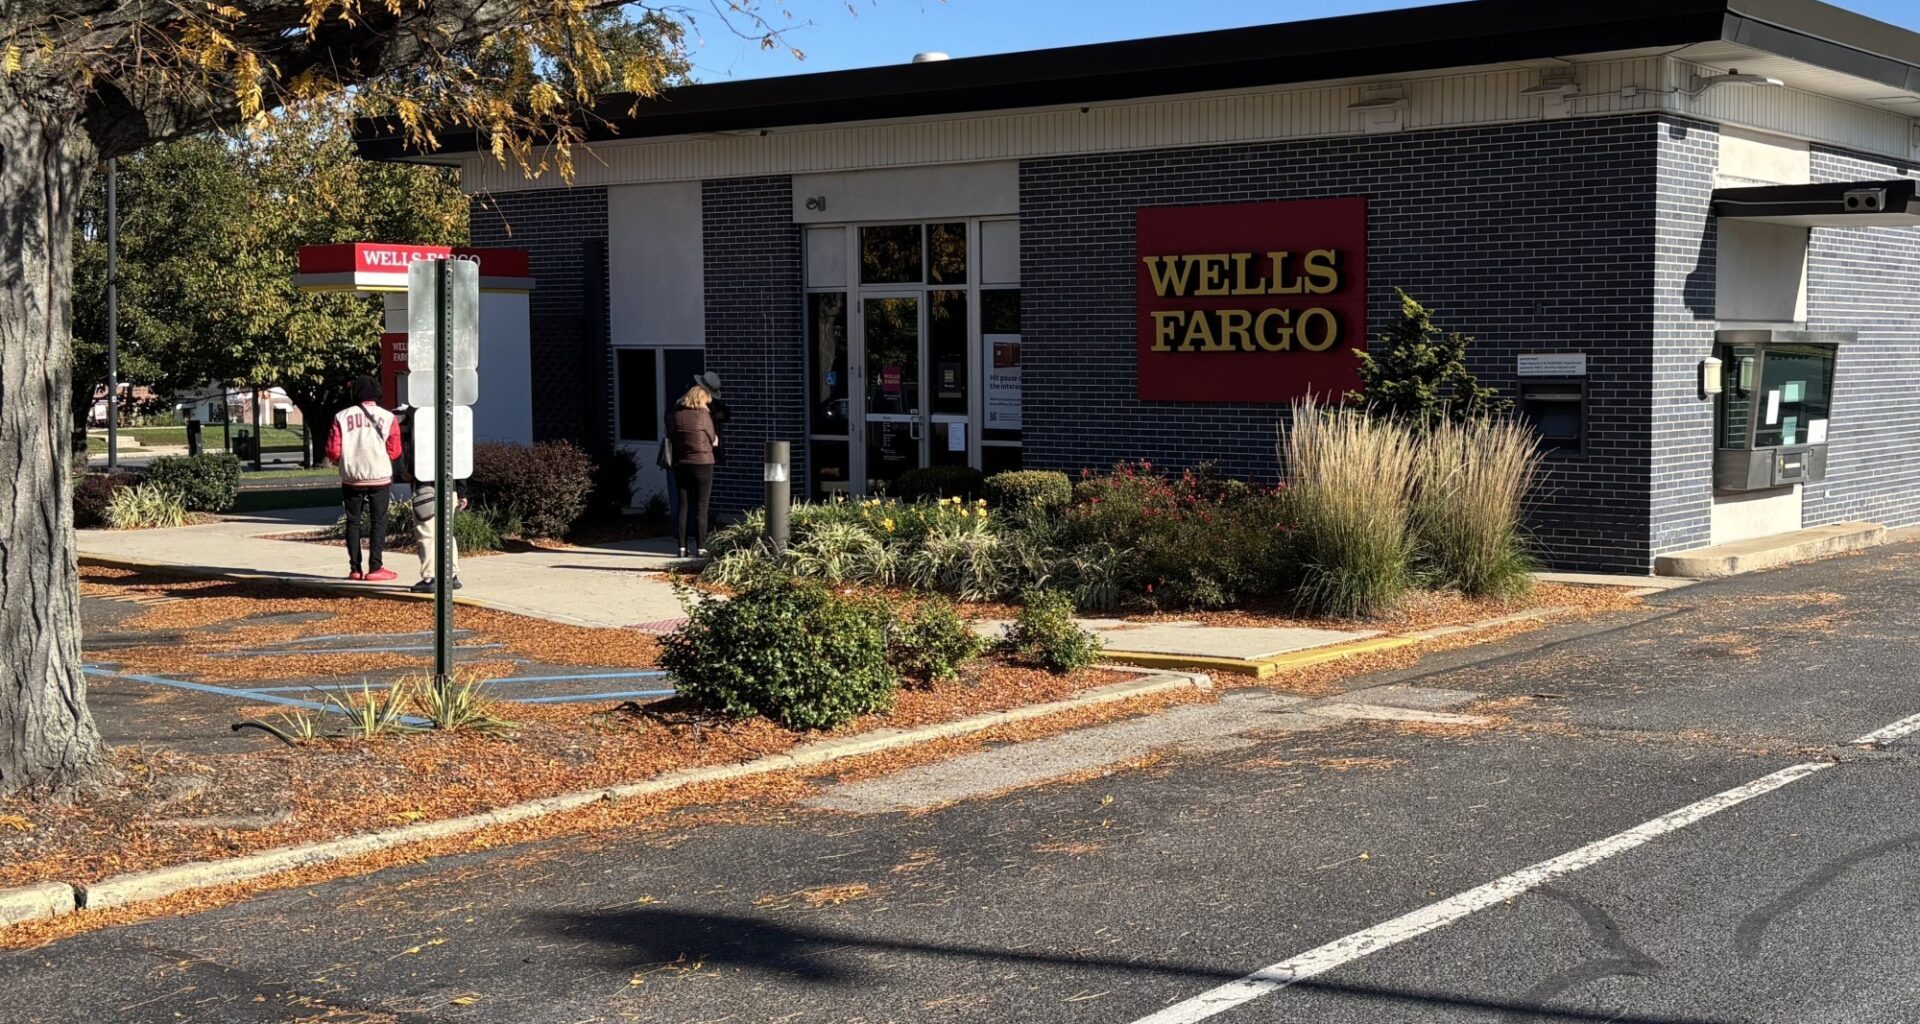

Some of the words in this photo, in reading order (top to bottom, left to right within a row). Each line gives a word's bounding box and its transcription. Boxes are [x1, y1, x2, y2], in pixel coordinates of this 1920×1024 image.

[362, 250, 422, 266] WELLS
[1142, 249, 1338, 297] WELLS
[1150, 307, 1338, 352] FARGO
[392, 342, 409, 351] WEL
[393, 353, 409, 362] FARG
